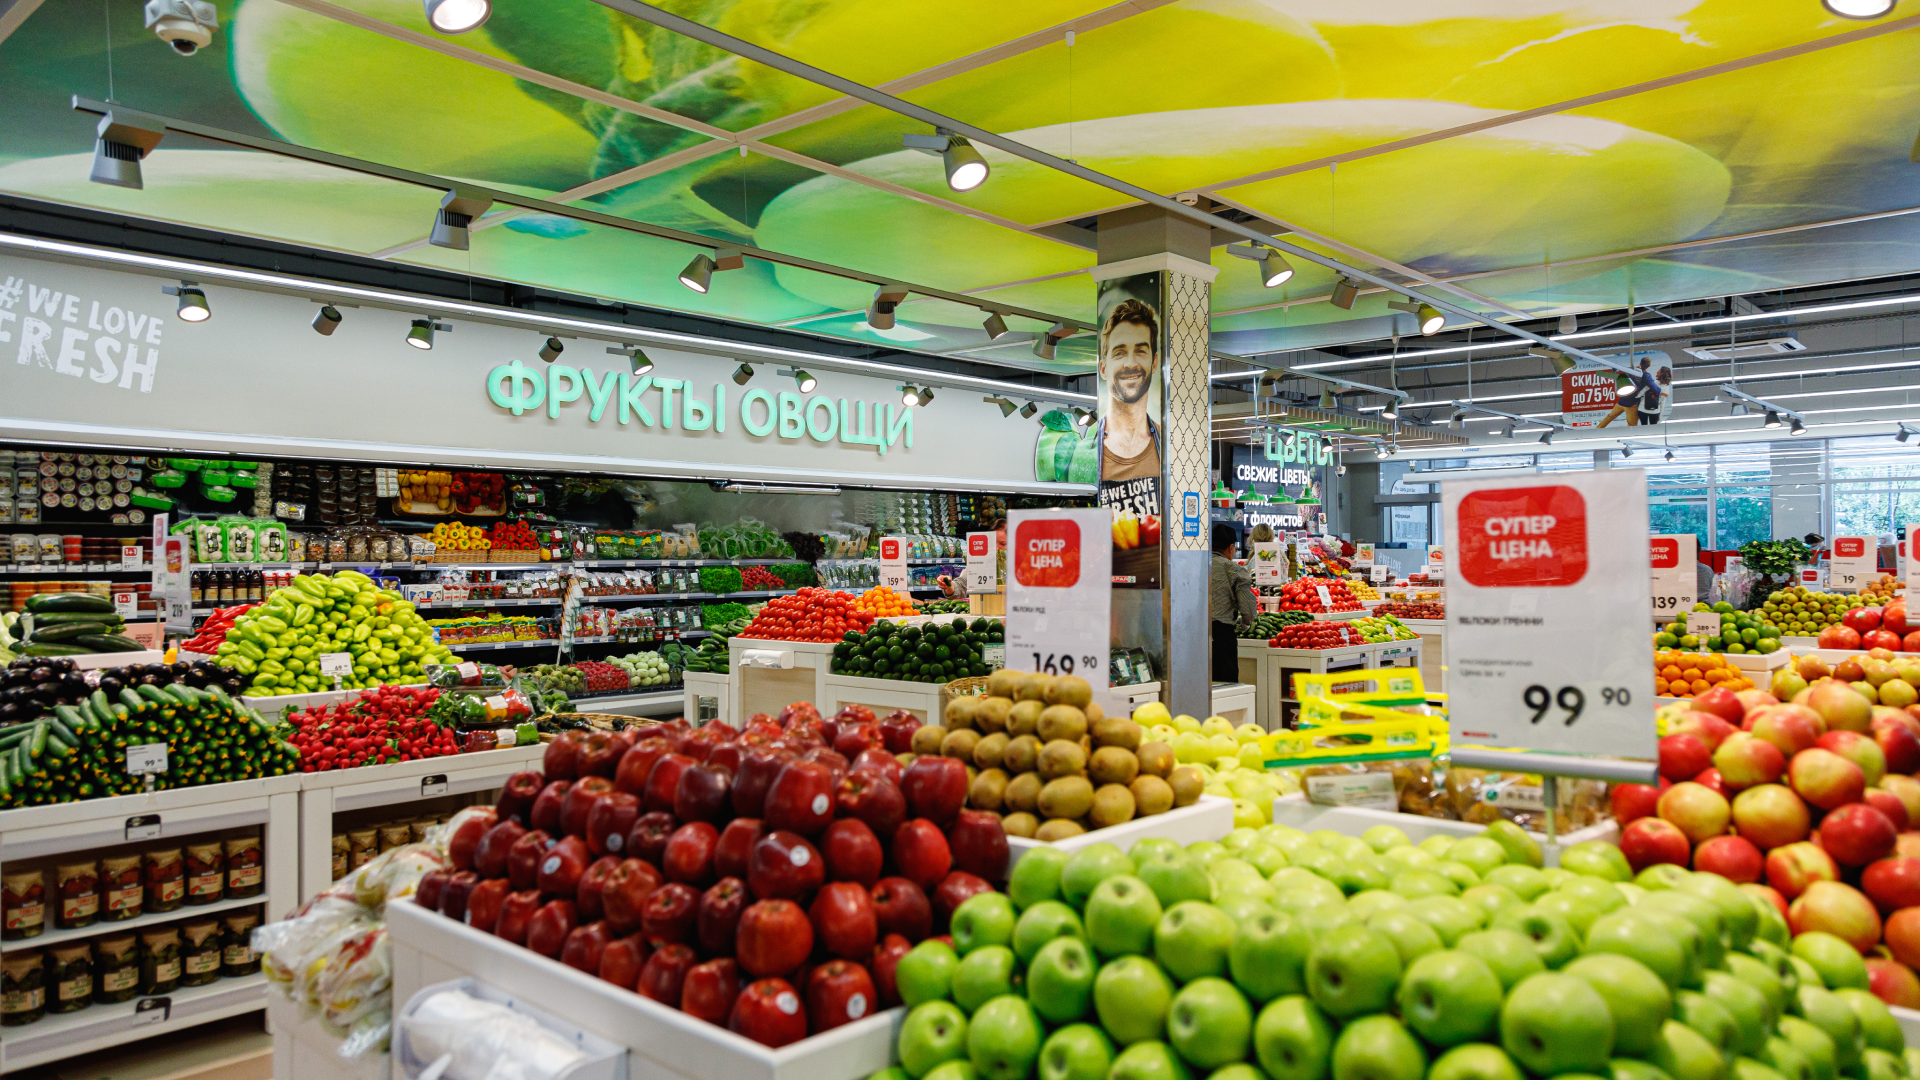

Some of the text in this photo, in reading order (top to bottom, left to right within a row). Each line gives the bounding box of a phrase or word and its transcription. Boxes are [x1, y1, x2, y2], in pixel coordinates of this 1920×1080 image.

[0, 276, 163, 345] #WE LOVE
[487, 360, 914, 456] ФРУКТЫ ОВОЩИ
[1264, 427, 1334, 469] ЦВЕТЫ
[1237, 464, 1311, 486] СВЕЖИЕ ЦВЕТЫ
[1100, 477, 1155, 506] #WE LOVE
[1102, 492, 1159, 523] RESH
[1250, 510, 1303, 531] флористов
[1484, 515, 1557, 537] СУПЕР
[1029, 539, 1066, 552] СУПЕР
[1489, 539, 1553, 561] ЦЕНА
[1030, 555, 1064, 569] ЦЕНА
[887, 577, 899, 586] 159
[977, 575, 988, 585] 29
[1843, 575, 1855, 584] 19
[1651, 596, 1677, 609] 139
[1033, 652, 1097, 676] 169 90
[1523, 684, 1631, 727] 99 90
